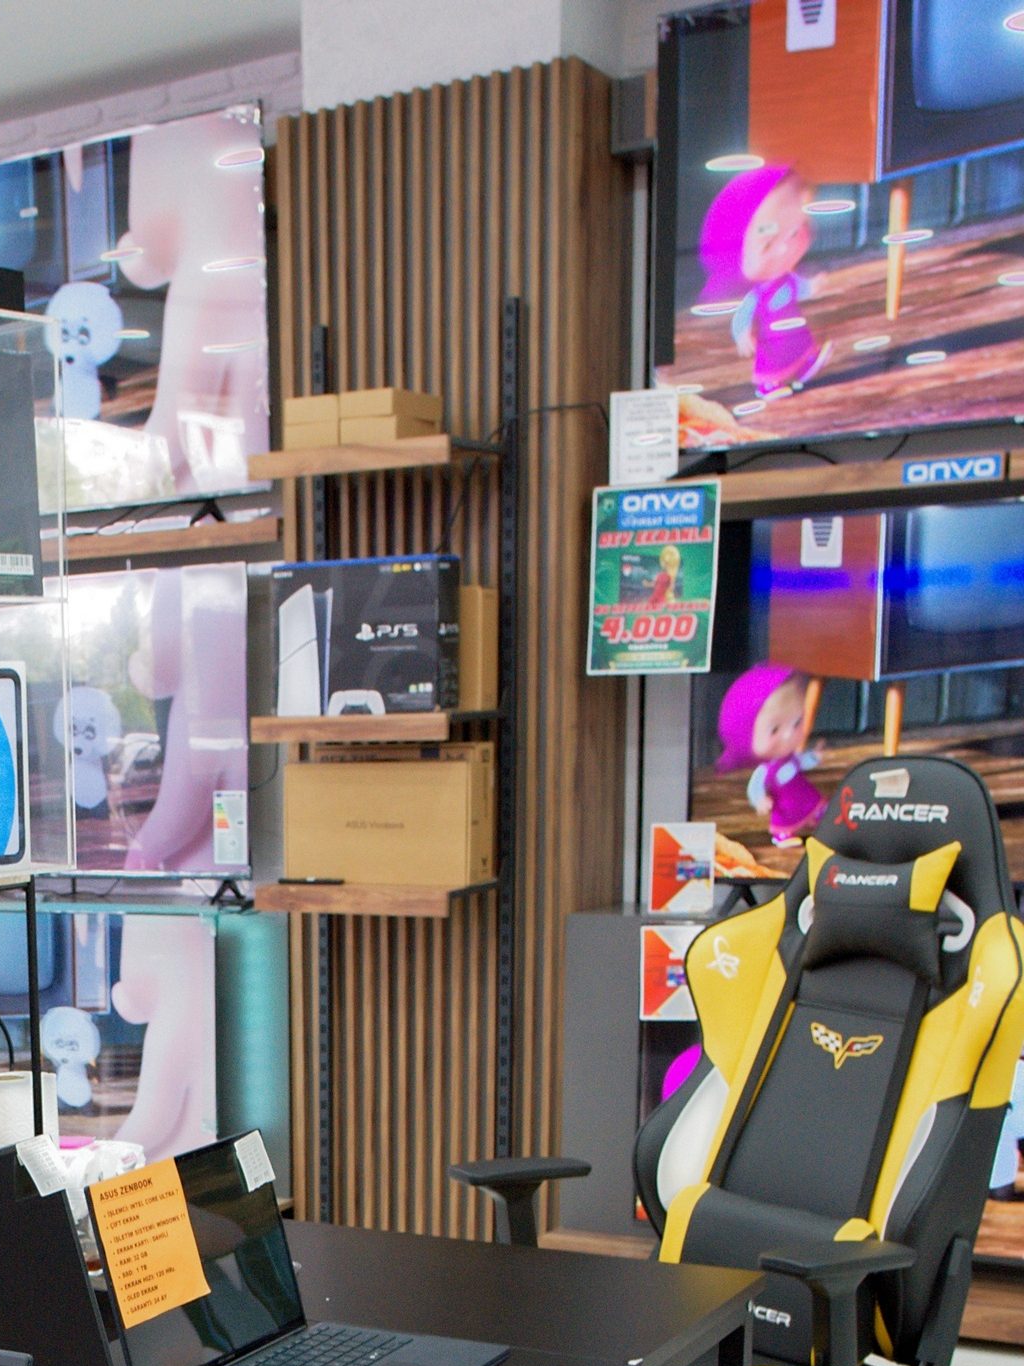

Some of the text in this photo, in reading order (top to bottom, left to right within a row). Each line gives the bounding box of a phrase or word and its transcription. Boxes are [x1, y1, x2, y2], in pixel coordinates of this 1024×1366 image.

[376, 623, 418, 638] PS5
[601, 613, 697, 645] 4.000
[99, 1178, 153, 1201] ASUS ZENBOOK
[159, 1191, 175, 1200] ULTRA
[123, 1215, 140, 1225] EKRAN
[116, 1244, 134, 1255] EKRAN
[124, 1279, 142, 1290] EKRAN
[127, 1285, 158, 1301] OLED EKRAN
